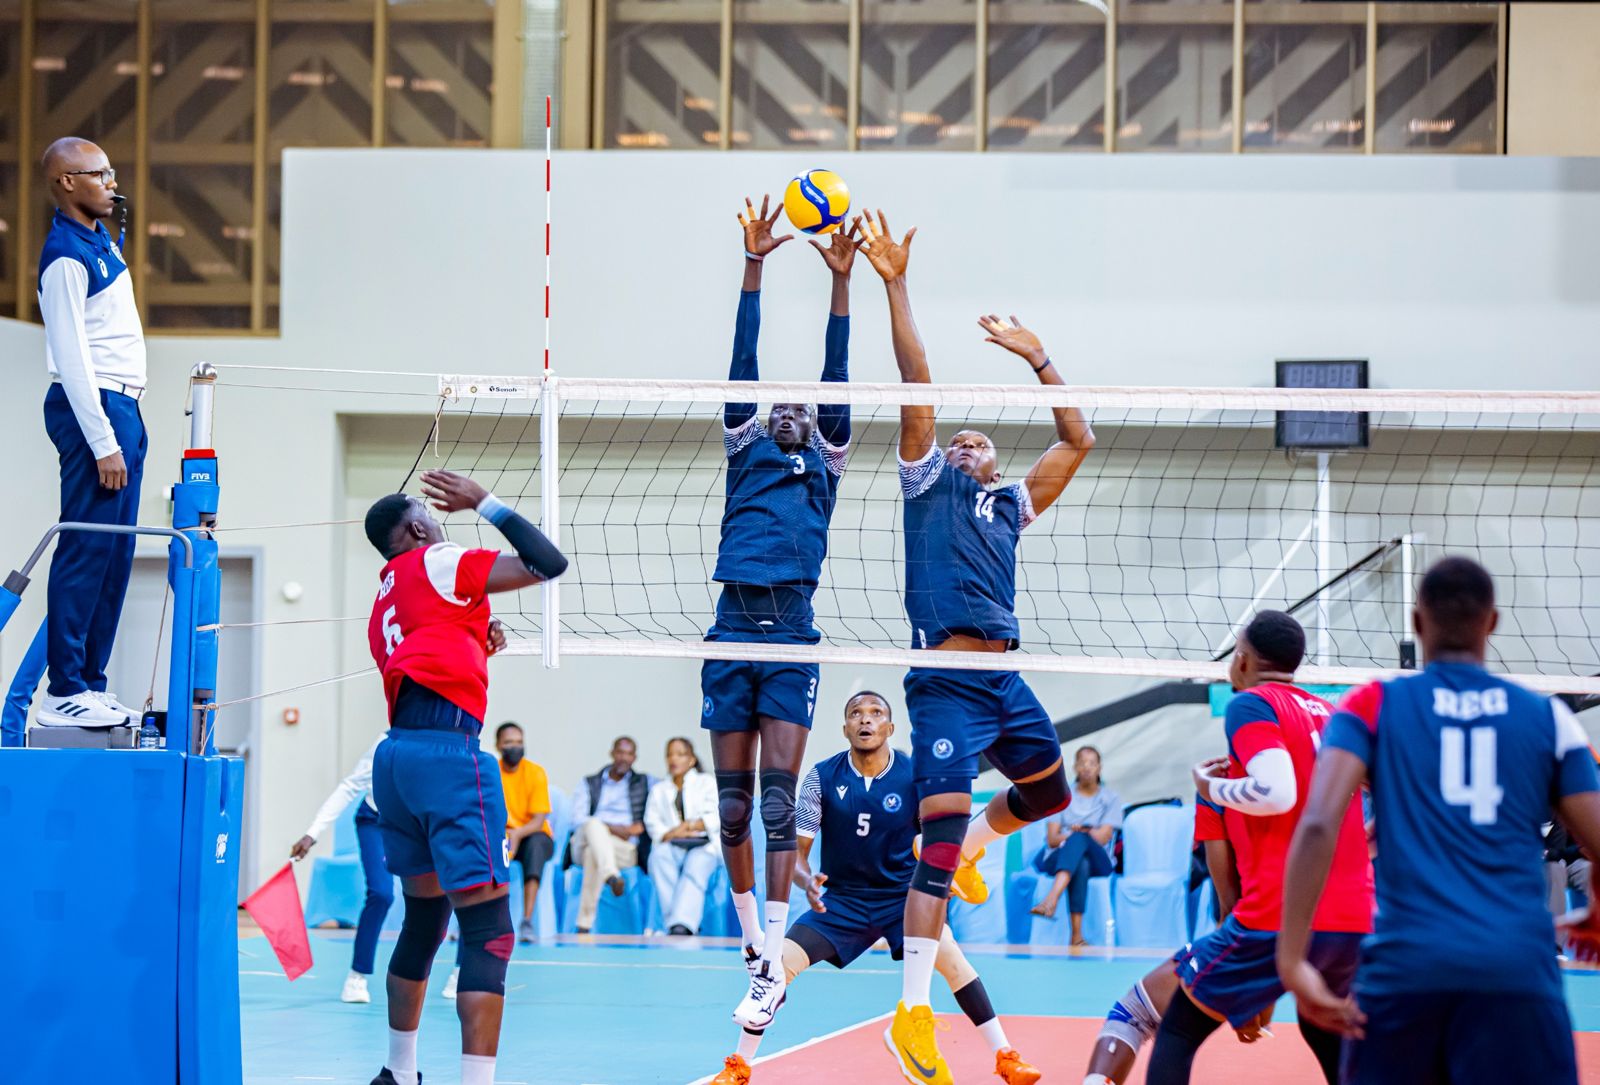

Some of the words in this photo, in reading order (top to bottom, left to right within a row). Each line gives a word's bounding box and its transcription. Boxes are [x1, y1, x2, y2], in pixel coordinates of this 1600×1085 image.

[191, 472, 210, 480] FIVB
[789, 454, 806, 475] 3
[975, 491, 996, 523] 14
[382, 604, 405, 657] 6
[807, 677, 817, 699] 3
[1432, 687, 1509, 721] REG
[1440, 726, 1504, 825] 4
[856, 812, 871, 837] 5
